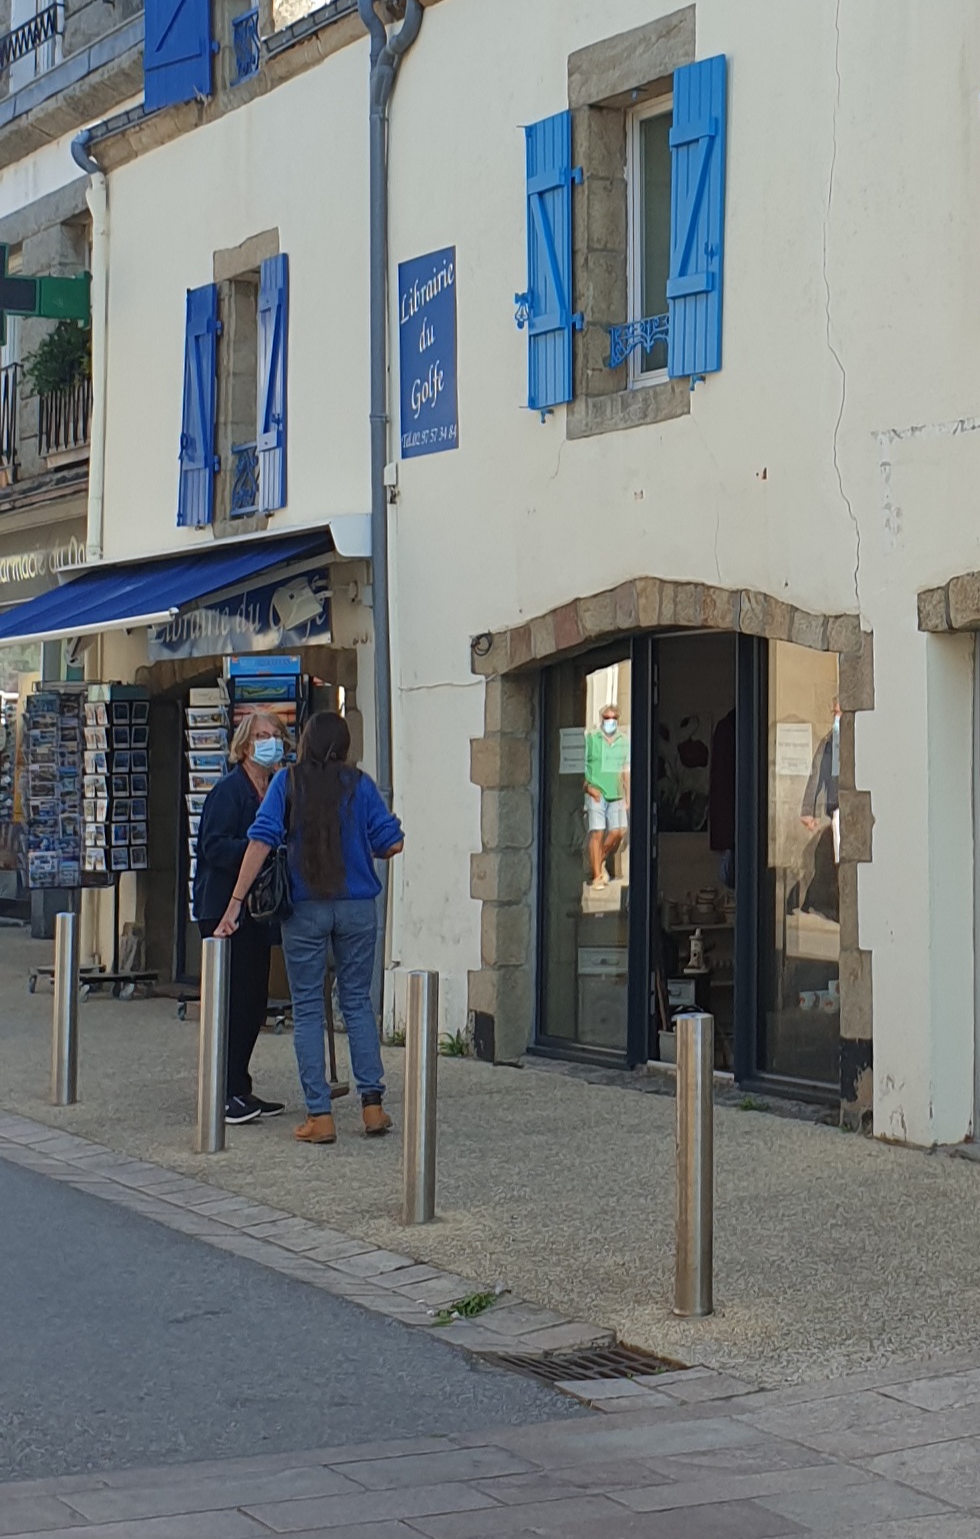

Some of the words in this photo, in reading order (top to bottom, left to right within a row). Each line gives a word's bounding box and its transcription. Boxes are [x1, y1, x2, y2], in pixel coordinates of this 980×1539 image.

[401, 258, 455, 325] Librairie
[419, 316, 435, 353] du
[411, 359, 445, 419] Golfe
[421, 429, 429, 445] 97
[430, 427, 438, 443] 57
[438, 426, 447, 441] 34
[235, 591, 262, 634] du
